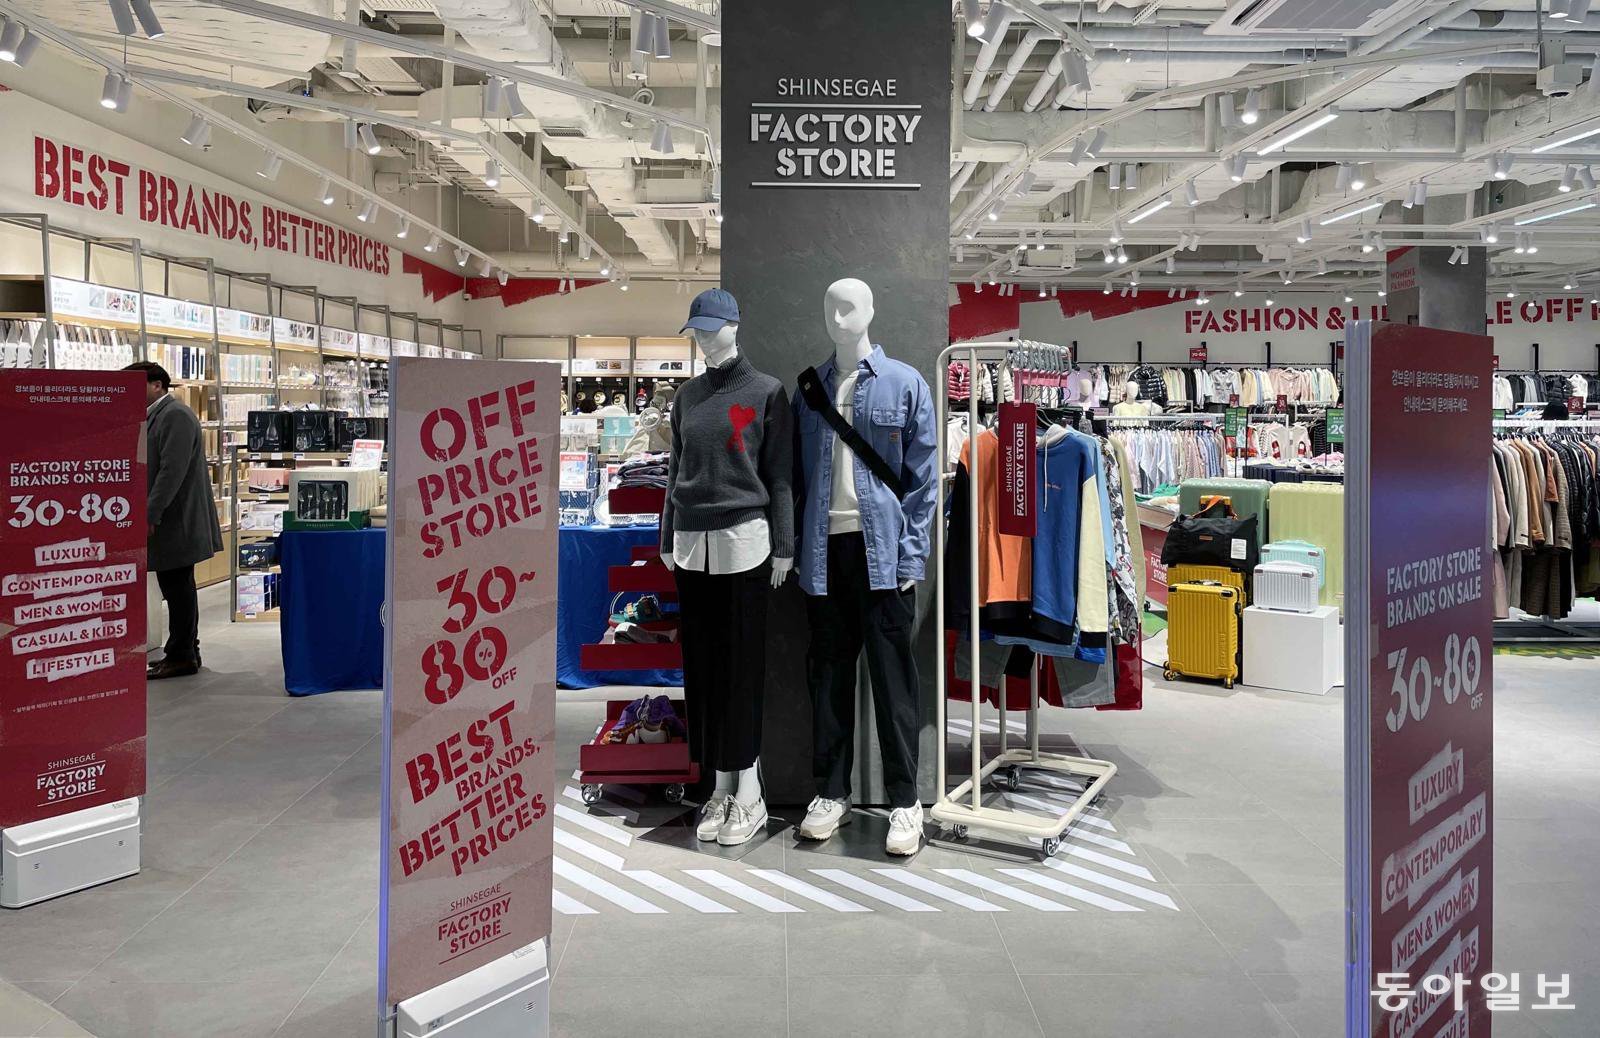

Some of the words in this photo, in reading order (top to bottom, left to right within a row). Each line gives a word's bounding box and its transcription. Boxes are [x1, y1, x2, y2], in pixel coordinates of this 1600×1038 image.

[777, 78, 897, 97] SHINSEGAE
[751, 113, 922, 143] FACTORY
[776, 147, 896, 177] STORE
[34, 136, 130, 216] BEST
[139, 169, 260, 251] BRANDS,
[262, 205, 336, 264] BETTER
[338, 229, 390, 276] PRICES
[1185, 306, 1318, 333] FASHION
[1326, 306, 1345, 330] &
[1521, 298, 1584, 323] OFF
[107, 386, 126, 394] 마시고
[420, 379, 535, 463] OFF
[1016, 422, 1024, 461] STORE
[10, 461, 81, 474] FACTORY
[84, 459, 130, 471] STORE
[10, 474, 69, 487] BRANDS
[73, 472, 94, 484] ON
[97, 471, 130, 482] SALE
[418, 437, 542, 517] PRICE
[1016, 461, 1024, 517] FACTORY
[420, 481, 542, 559] STORE
[42, 545, 101, 562] LUXURY
[7, 569, 132, 593] CONTEMPORARY
[1387, 556, 1444, 595] FACTORY
[1447, 547, 1481, 578] STORE
[20, 606, 52, 620] MEN
[54, 605, 65, 616] &
[67, 598, 121, 614] WOMEN
[1387, 589, 1435, 628] BRANDS
[1438, 585, 1455, 610] ON
[1457, 575, 1481, 604] SALE
[17, 631, 78, 648] CASUAL
[79, 629, 90, 640] &
[92, 624, 124, 638] KIDS
[32, 653, 110, 675] LIFESTYLE
[492, 667, 517, 689] OFF
[1470, 692, 1483, 710] OFF
[47, 753, 96, 769] SHINSEGAE
[405, 700, 515, 804] BEST
[455, 737, 540, 801] BRANDS,
[37, 764, 106, 790] FACTORY
[47, 779, 96, 800] STORE
[1414, 759, 1460, 812] LUXURY
[399, 772, 527, 878] BETTER
[450, 793, 547, 877] PRICES
[1386, 807, 1483, 901] CONTEMPORARY
[450, 882, 501, 912] SHINSEGAE
[438, 897, 512, 941] FACTORY
[1397, 928, 1423, 968] MEN
[1424, 917, 1433, 938] &
[1434, 878, 1475, 928] WOMEN
[449, 919, 501, 954] STORE
[1453, 941, 1477, 975] KIDS
